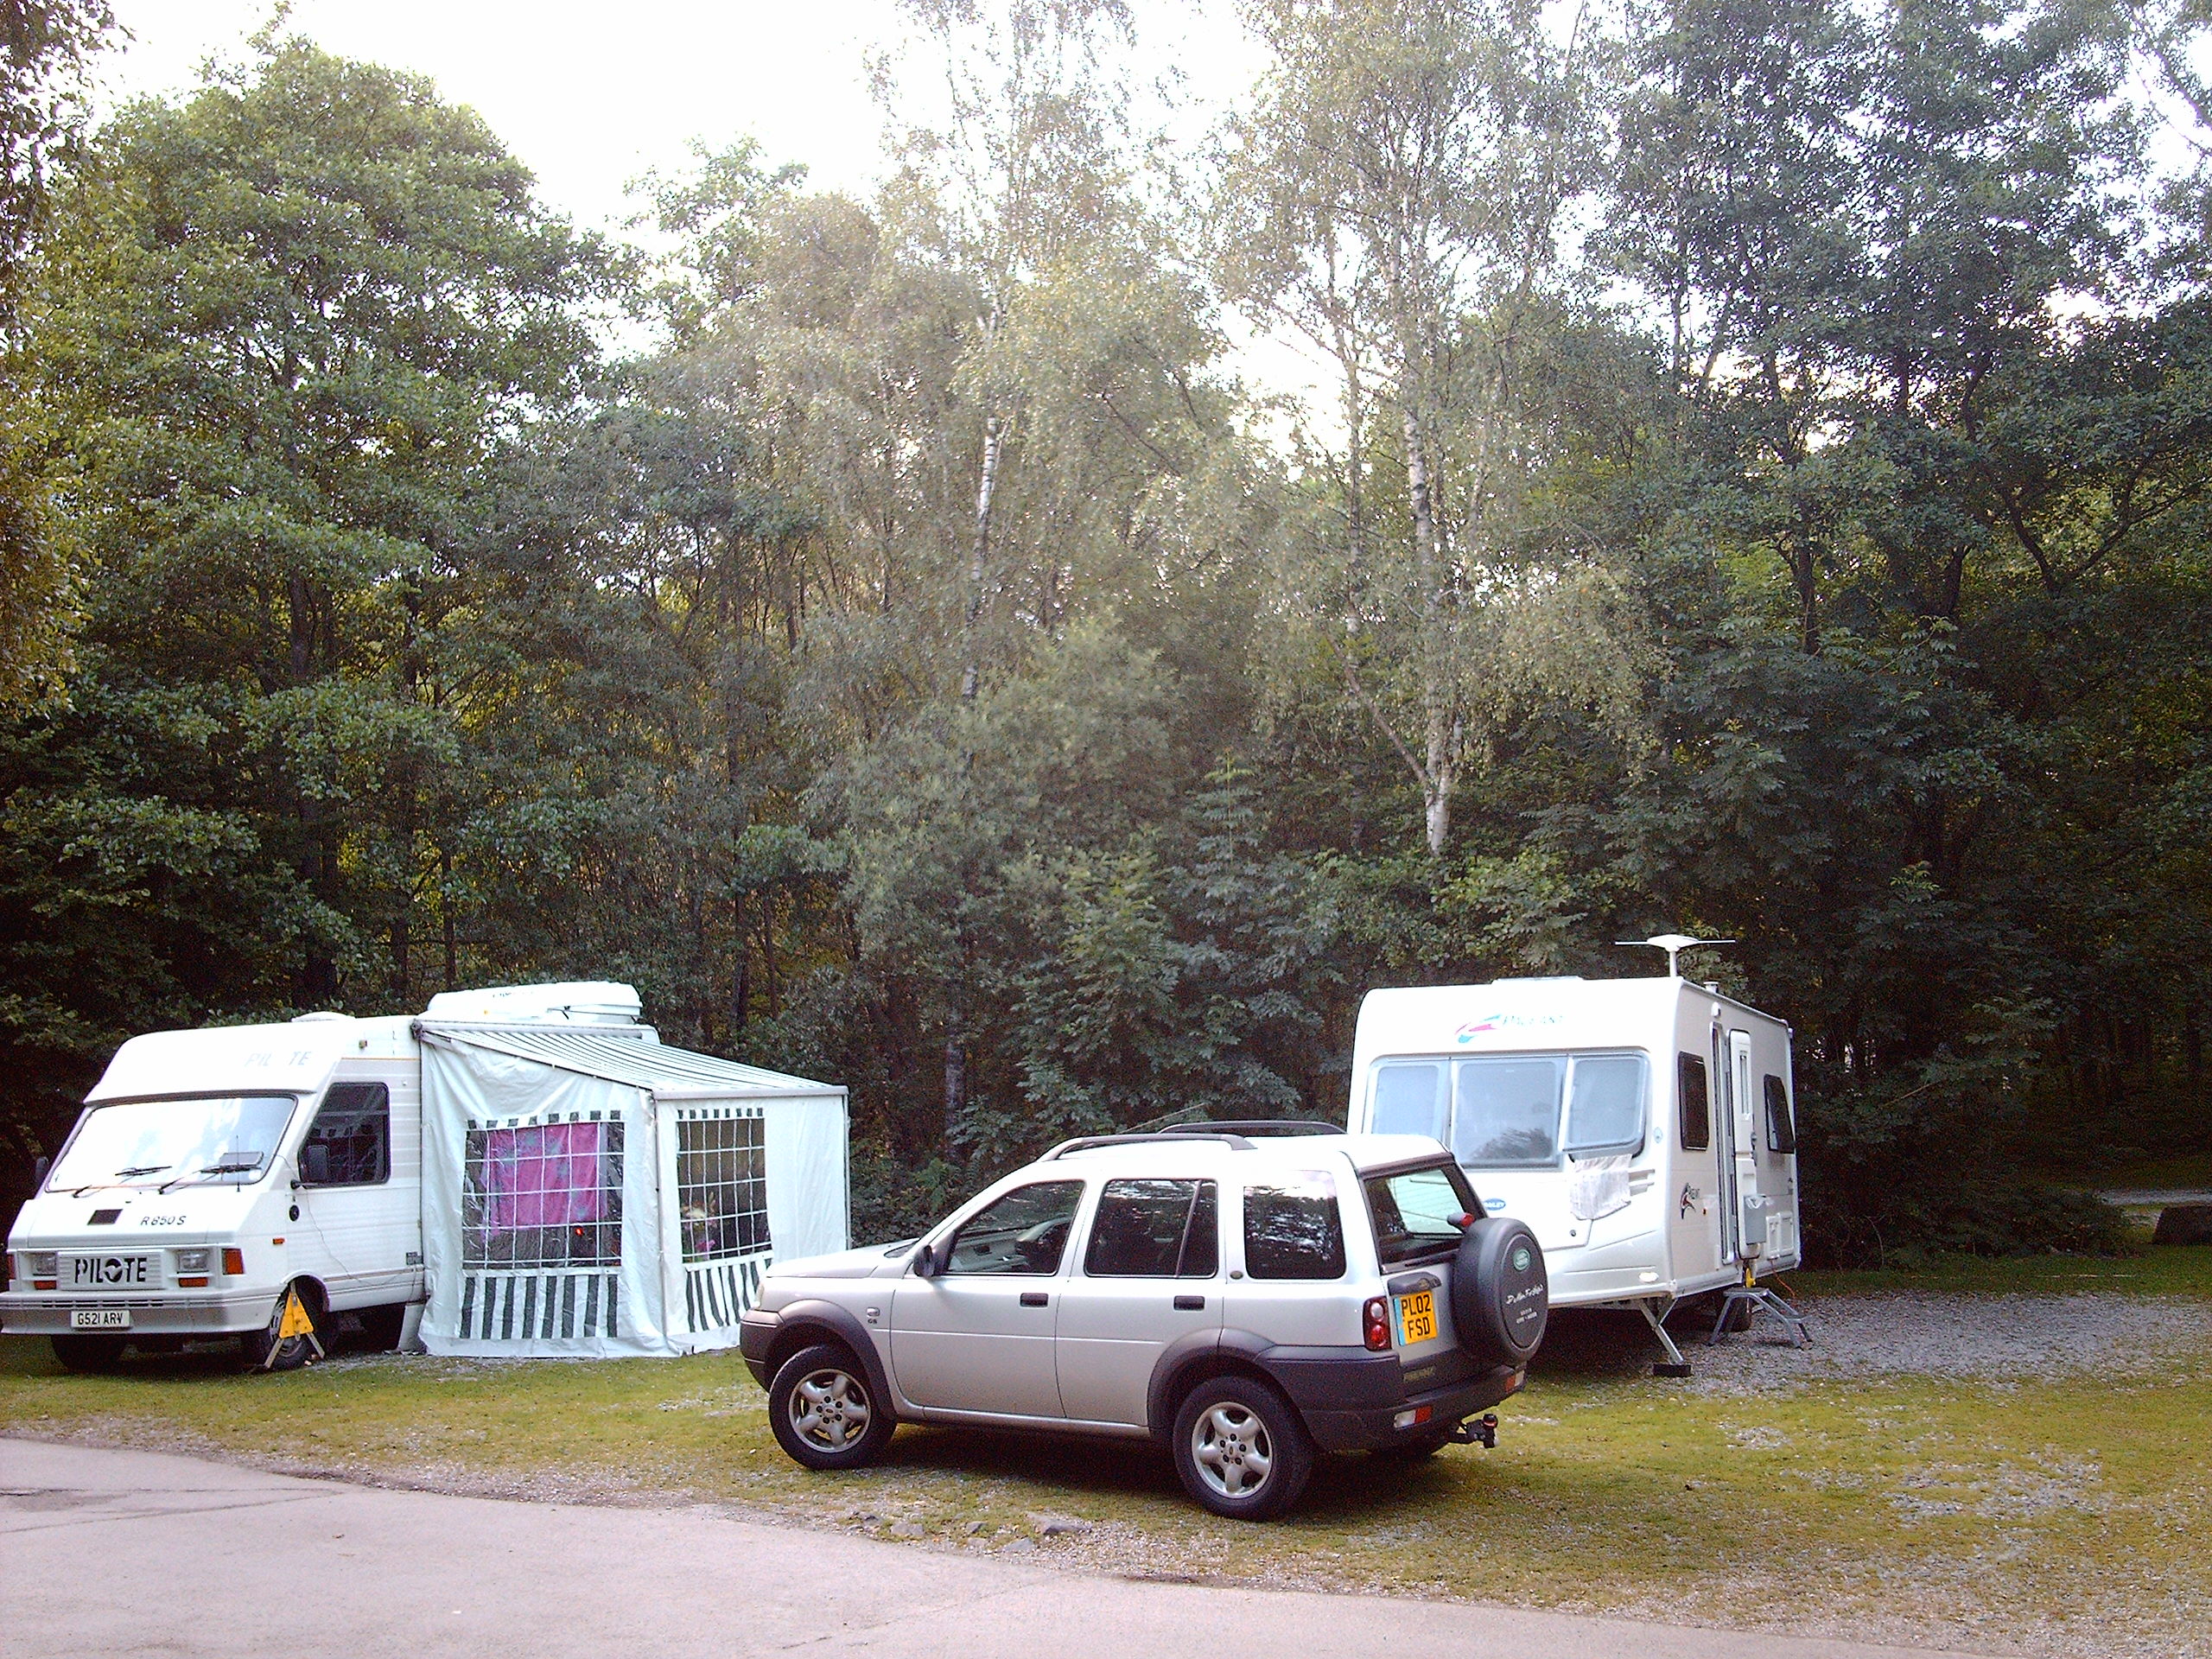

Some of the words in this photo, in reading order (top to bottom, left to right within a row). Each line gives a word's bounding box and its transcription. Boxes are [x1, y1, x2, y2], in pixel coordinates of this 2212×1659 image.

[244, 1051, 312, 1067] PILTE
[74, 1257, 147, 1283] PILOTE
[1401, 1294, 1431, 1317] PL02
[78, 1313, 101, 1325] G521
[103, 1313, 123, 1325] ARV
[1408, 1317, 1430, 1338] FSD
